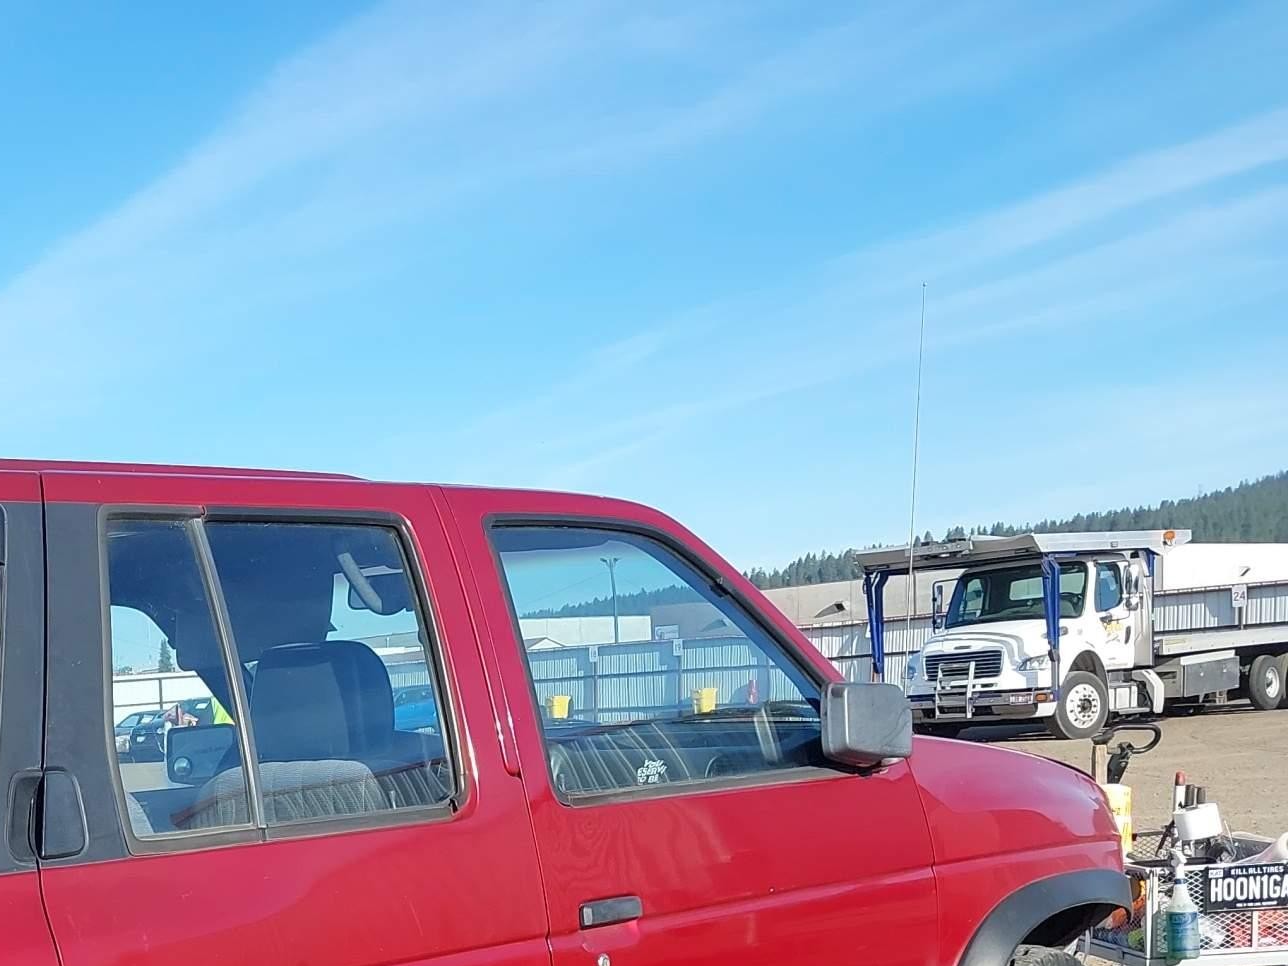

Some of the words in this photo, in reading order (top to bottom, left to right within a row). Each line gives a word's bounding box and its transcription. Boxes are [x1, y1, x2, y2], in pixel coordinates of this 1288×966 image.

[1233, 591, 1246, 601] 24
[644, 759, 665, 769] YOU
[1262, 865, 1285, 874] TIRES
